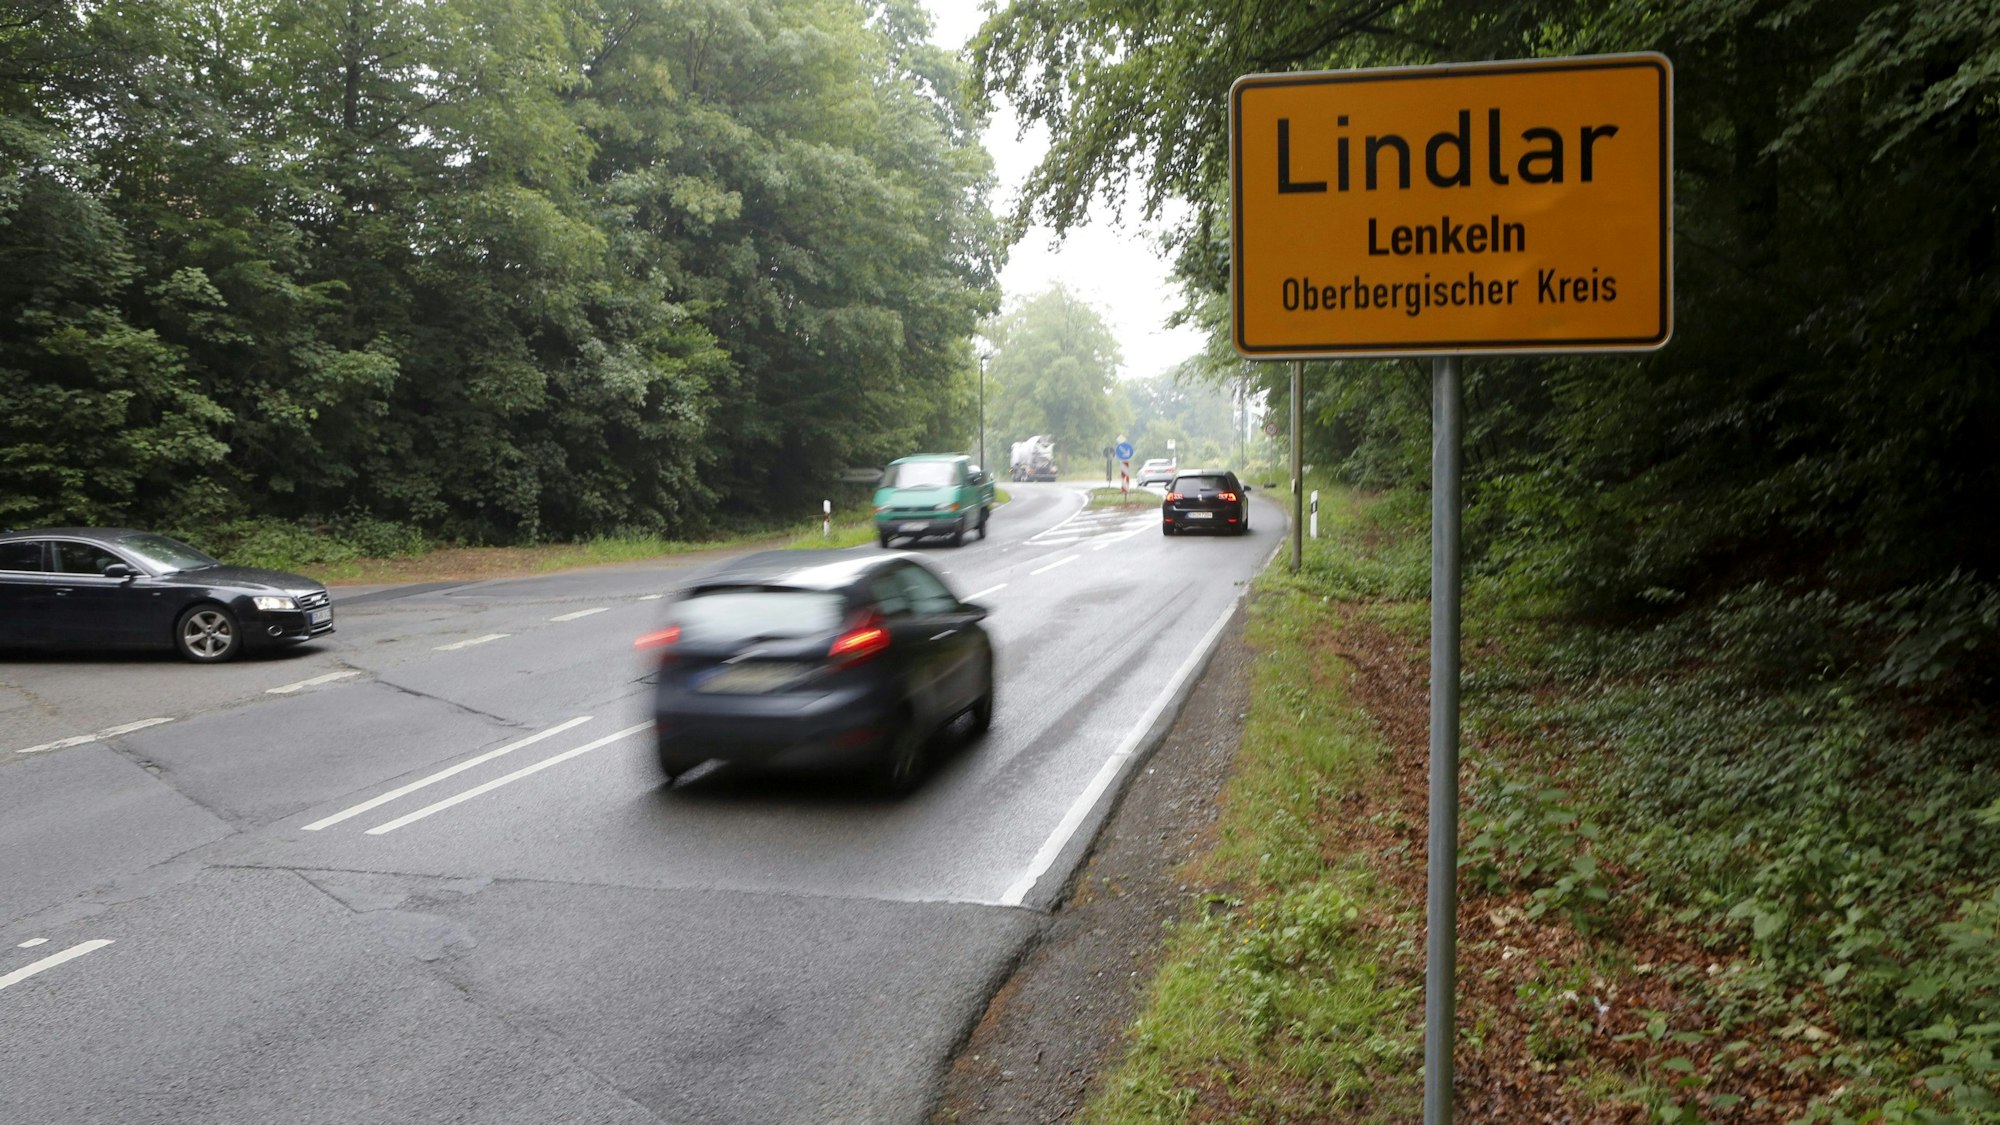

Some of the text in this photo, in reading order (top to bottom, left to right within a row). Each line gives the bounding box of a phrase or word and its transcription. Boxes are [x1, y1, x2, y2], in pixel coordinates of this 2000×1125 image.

[1276, 107, 1620, 194] Lindlar
[1368, 214, 1526, 257] Lenkeln
[1282, 267, 1618, 317] Oberbergischer Kreis
